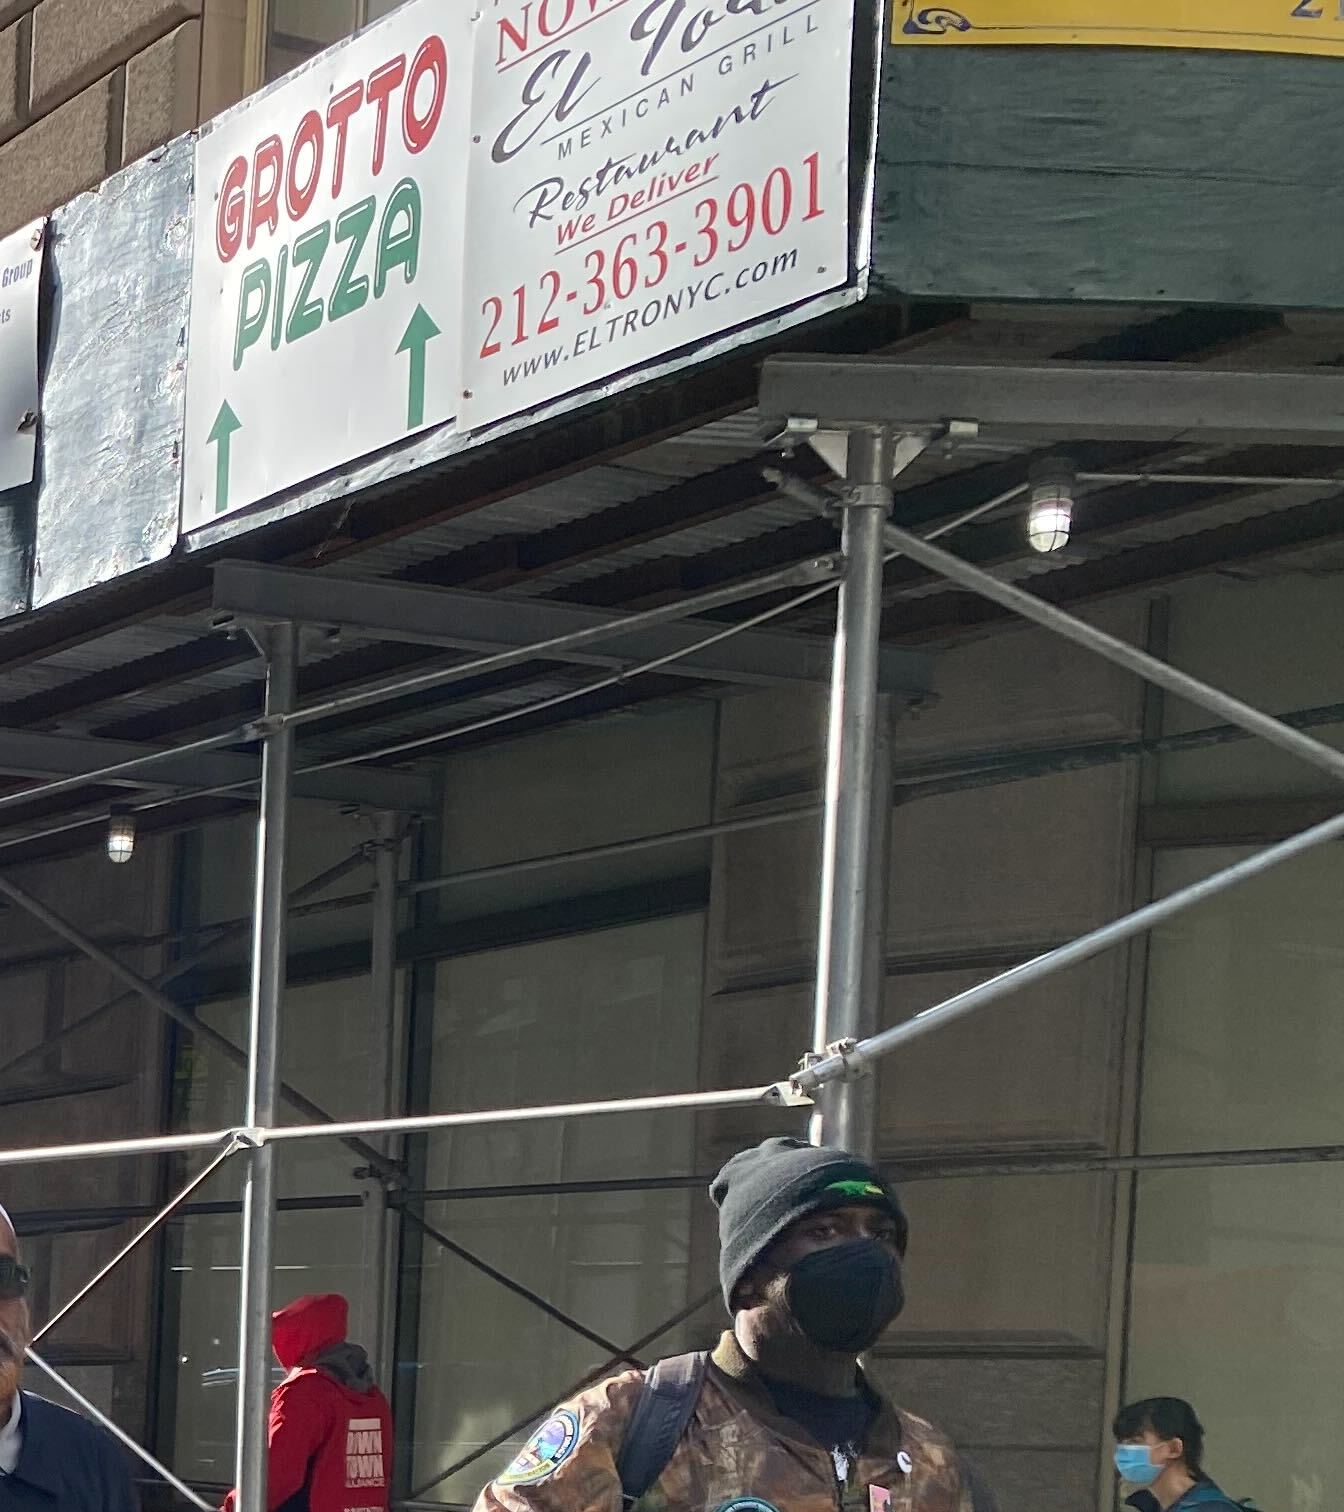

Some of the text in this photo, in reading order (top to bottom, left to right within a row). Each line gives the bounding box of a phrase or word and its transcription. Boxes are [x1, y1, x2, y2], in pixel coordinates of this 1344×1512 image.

[216, 35, 447, 263] GROTTO
[491, 49, 601, 163] El
[514, 74, 799, 228] Restaurant
[558, 14, 818, 160] MEXICAN GRILL
[480, 151, 826, 359] 212-363-3901
[556, 153, 720, 246] We Deliver
[2, 259, 33, 288] Group
[233, 177, 422, 371] PIZZA
[502, 248, 798, 386] www.ELTRONYC.com
